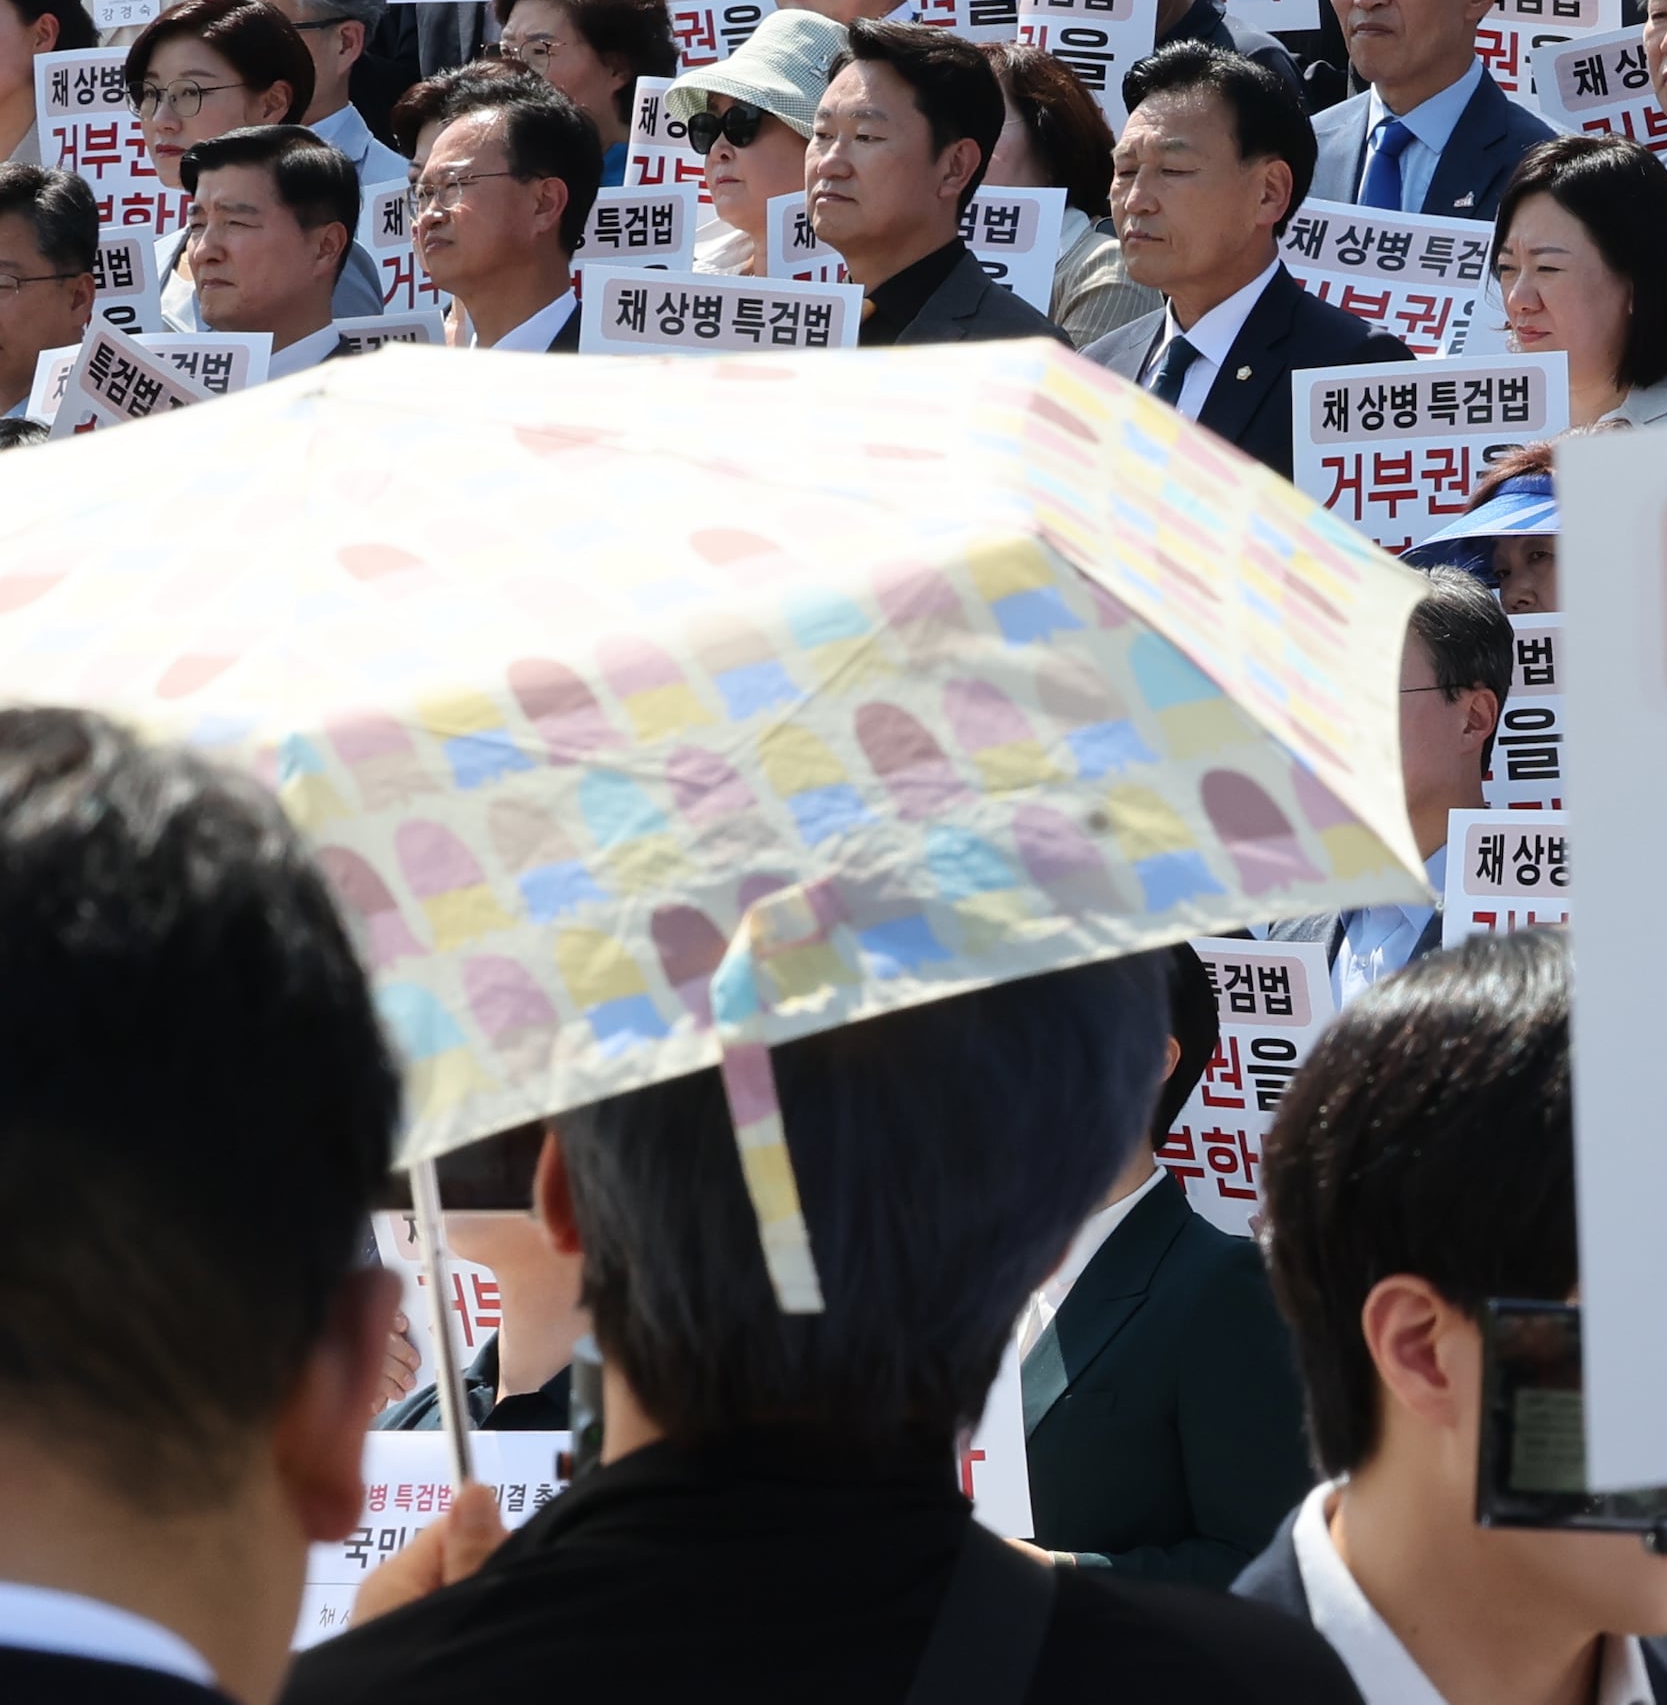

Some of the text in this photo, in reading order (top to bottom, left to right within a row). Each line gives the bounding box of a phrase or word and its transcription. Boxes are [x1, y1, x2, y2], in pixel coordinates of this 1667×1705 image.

[51, 68, 71, 107] 채
[594, 202, 675, 248] 특검법
[1289, 217, 1413, 271] 채 상병
[616, 292, 833, 346] 채 상병 특검법
[87, 341, 163, 419] 특검법
[1321, 375, 1530, 434] 채 상병 특검법
[1476, 833, 1505, 886] 채
